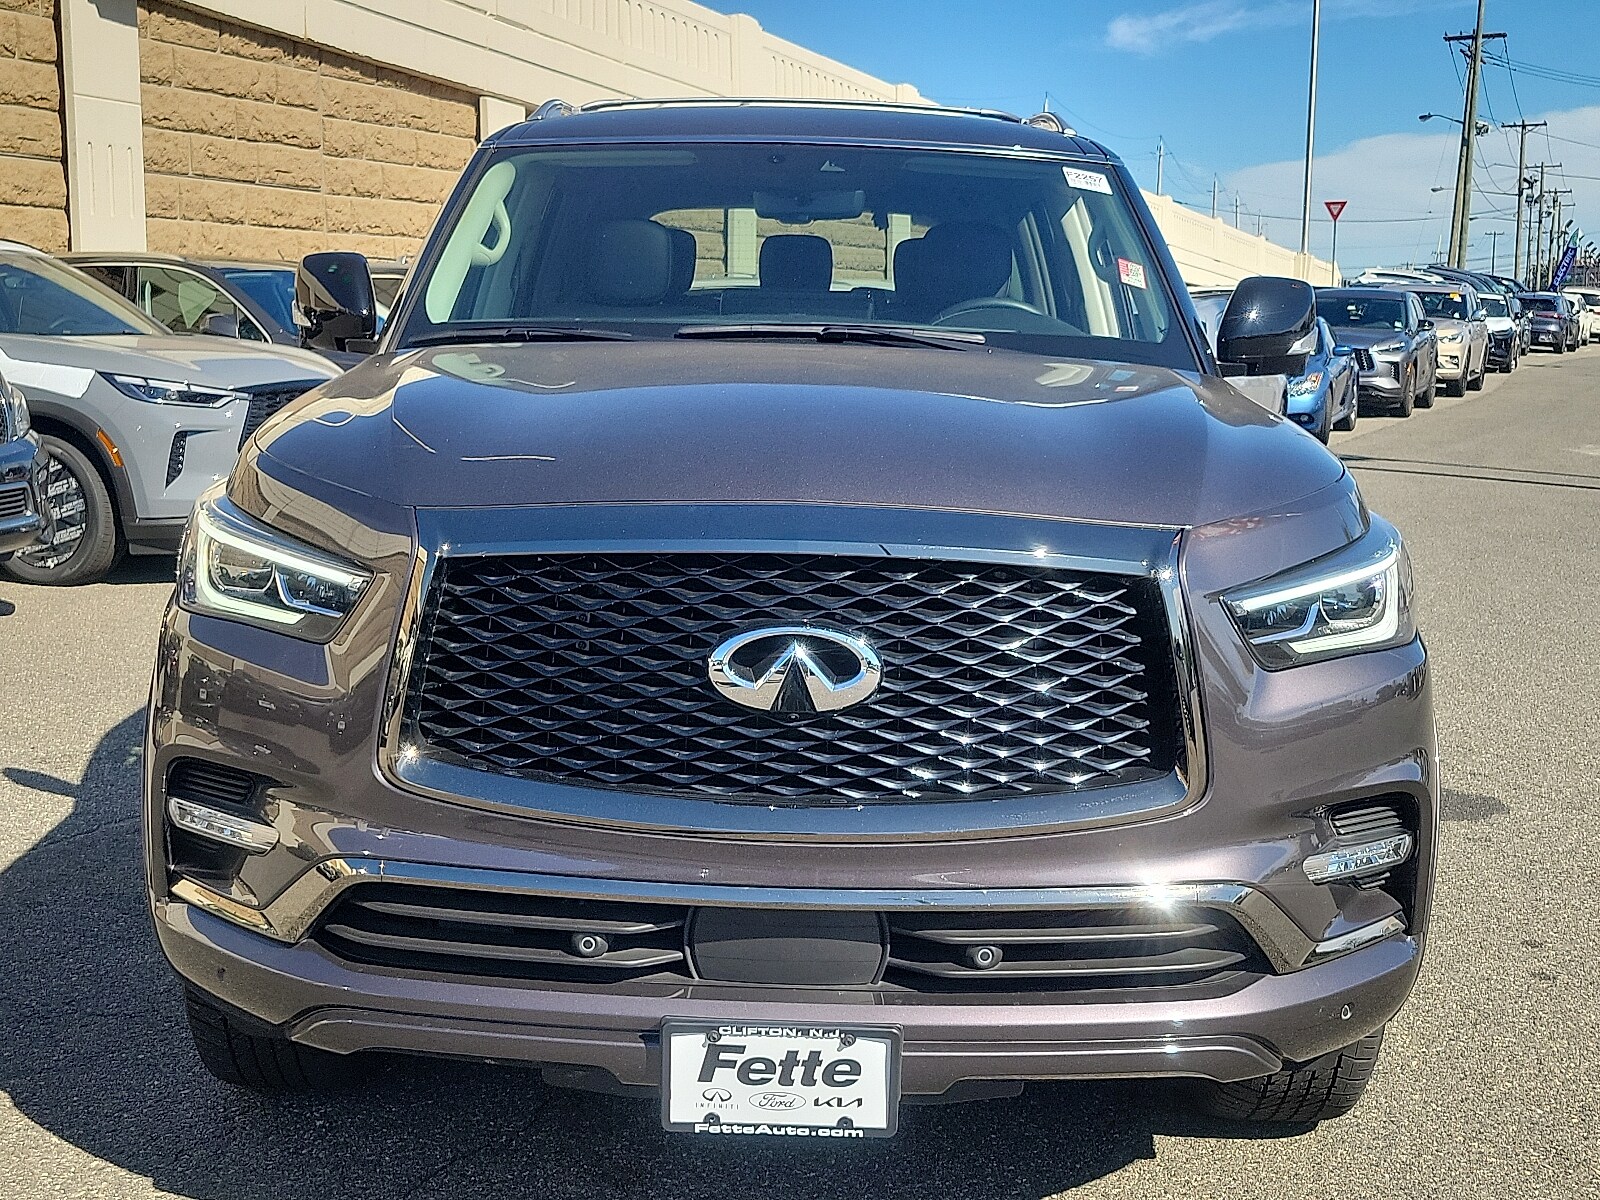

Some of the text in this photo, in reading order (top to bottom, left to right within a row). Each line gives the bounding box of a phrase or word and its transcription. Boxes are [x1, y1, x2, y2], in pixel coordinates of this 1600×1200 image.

[697, 1044, 862, 1087] Fette
[695, 1102, 739, 1110] INFINITI
[758, 1094, 796, 1108] Ford
[813, 1096, 863, 1108] KIA
